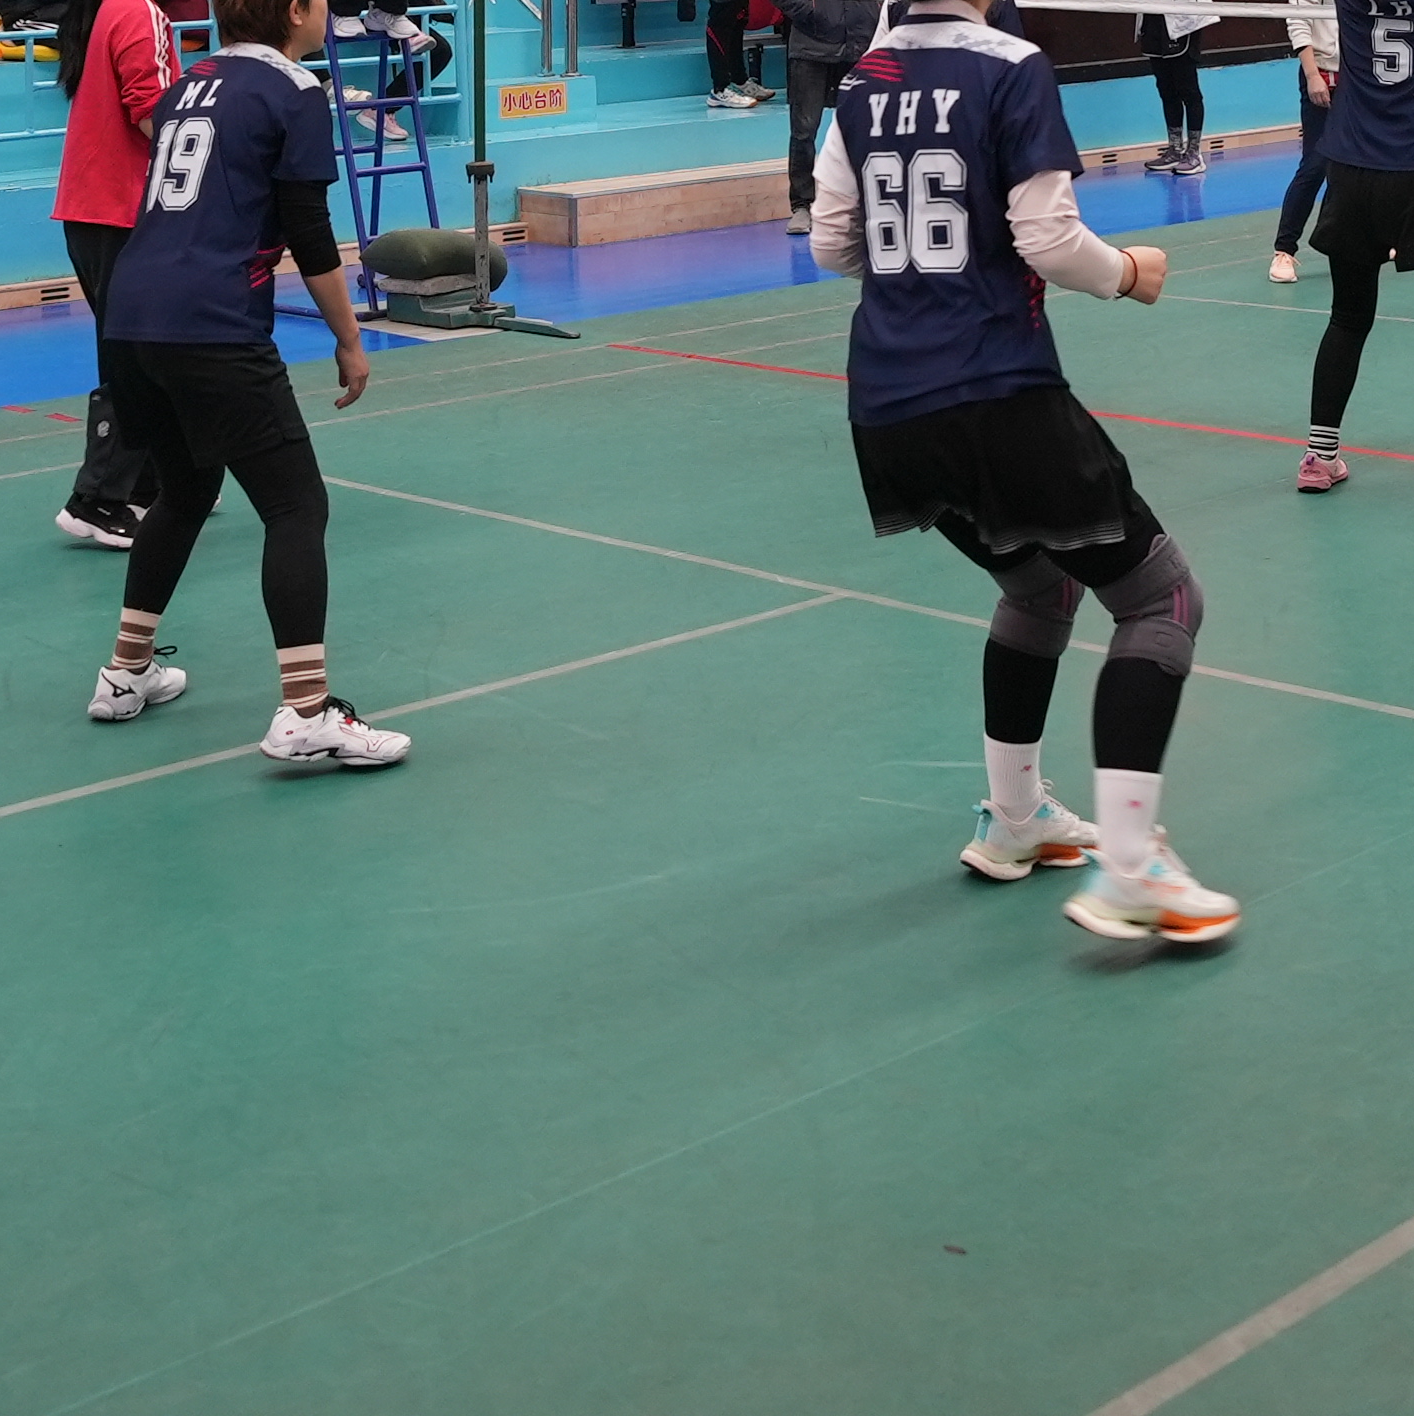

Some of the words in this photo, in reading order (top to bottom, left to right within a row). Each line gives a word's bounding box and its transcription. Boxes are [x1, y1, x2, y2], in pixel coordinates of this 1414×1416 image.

[1371, 17, 1414, 85] 5
[503, 88, 562, 112] 小心台阶
[145, 116, 216, 214] 19
[861, 148, 970, 274] 66
